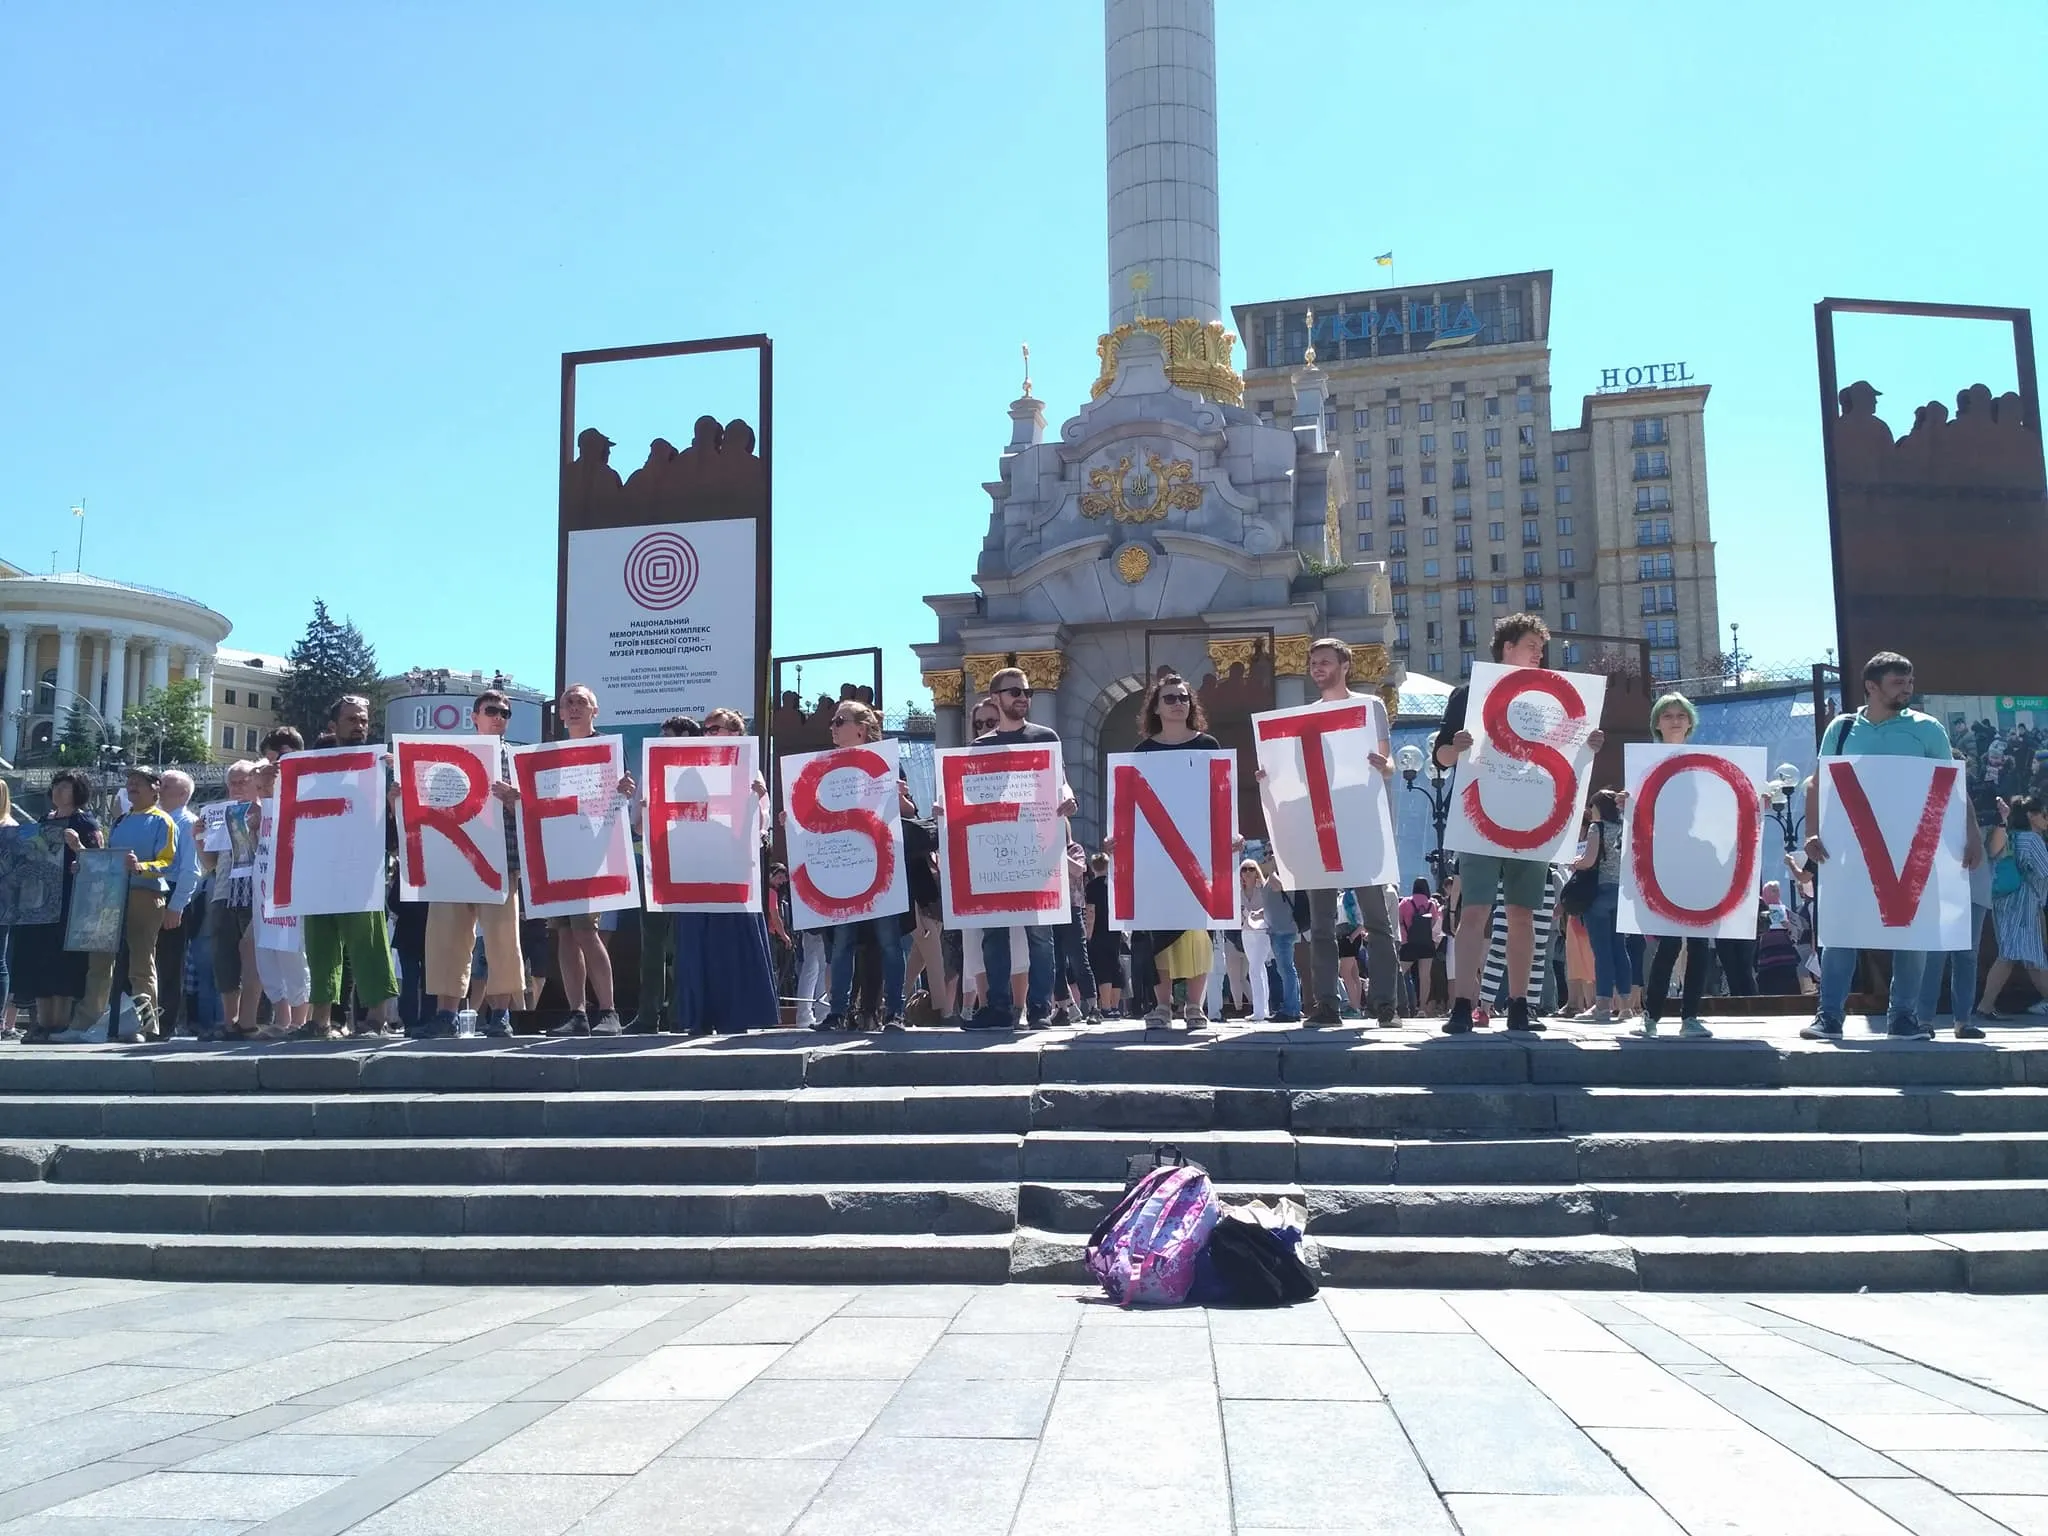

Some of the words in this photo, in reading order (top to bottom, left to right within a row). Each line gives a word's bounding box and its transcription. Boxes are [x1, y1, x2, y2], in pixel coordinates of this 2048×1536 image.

[1600, 361, 1695, 387] HOTEL
[630, 617, 690, 628] НАЦІОНАЛЬНИЙ
[609, 628, 669, 639] МЕМОРІАЛЬНИЙ
[670, 626, 711, 635] КОМПЛЕКС
[641, 637, 677, 646] НЕБЕСНОЇ
[678, 636, 700, 644] СОТНІ
[609, 648, 634, 657] МУЗЕЙ
[635, 646, 677, 656] РЕВОЛЮЦІЇ
[677, 645, 712, 654] ГІДНОСТІ
[615, 705, 705, 716] www.maidanmuseum.org
[976, 832, 1019, 845] TODAY
